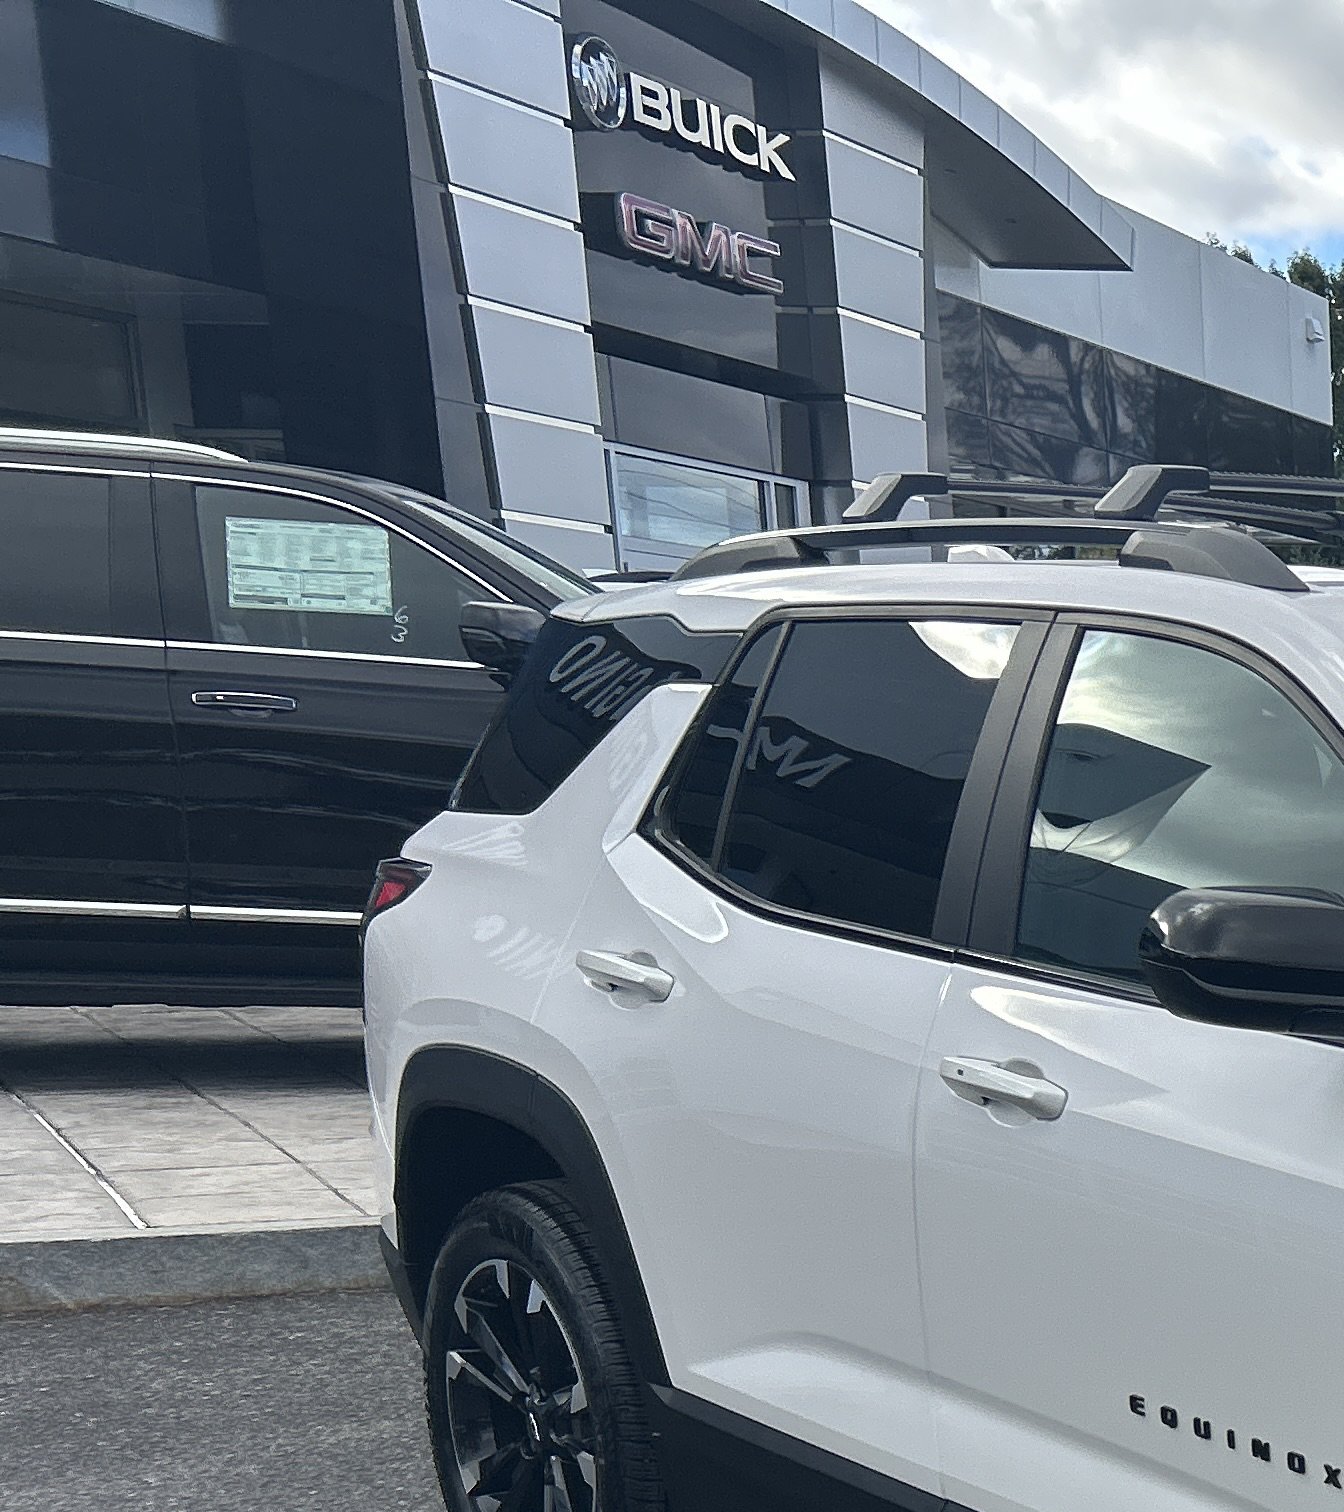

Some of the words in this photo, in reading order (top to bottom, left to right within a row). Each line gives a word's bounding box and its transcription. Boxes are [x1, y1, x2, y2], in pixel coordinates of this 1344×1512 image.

[630, 72, 796, 182] BUICK
[620, 192, 784, 295] GMC
[1129, 1394, 1343, 1490] EQUINOX
